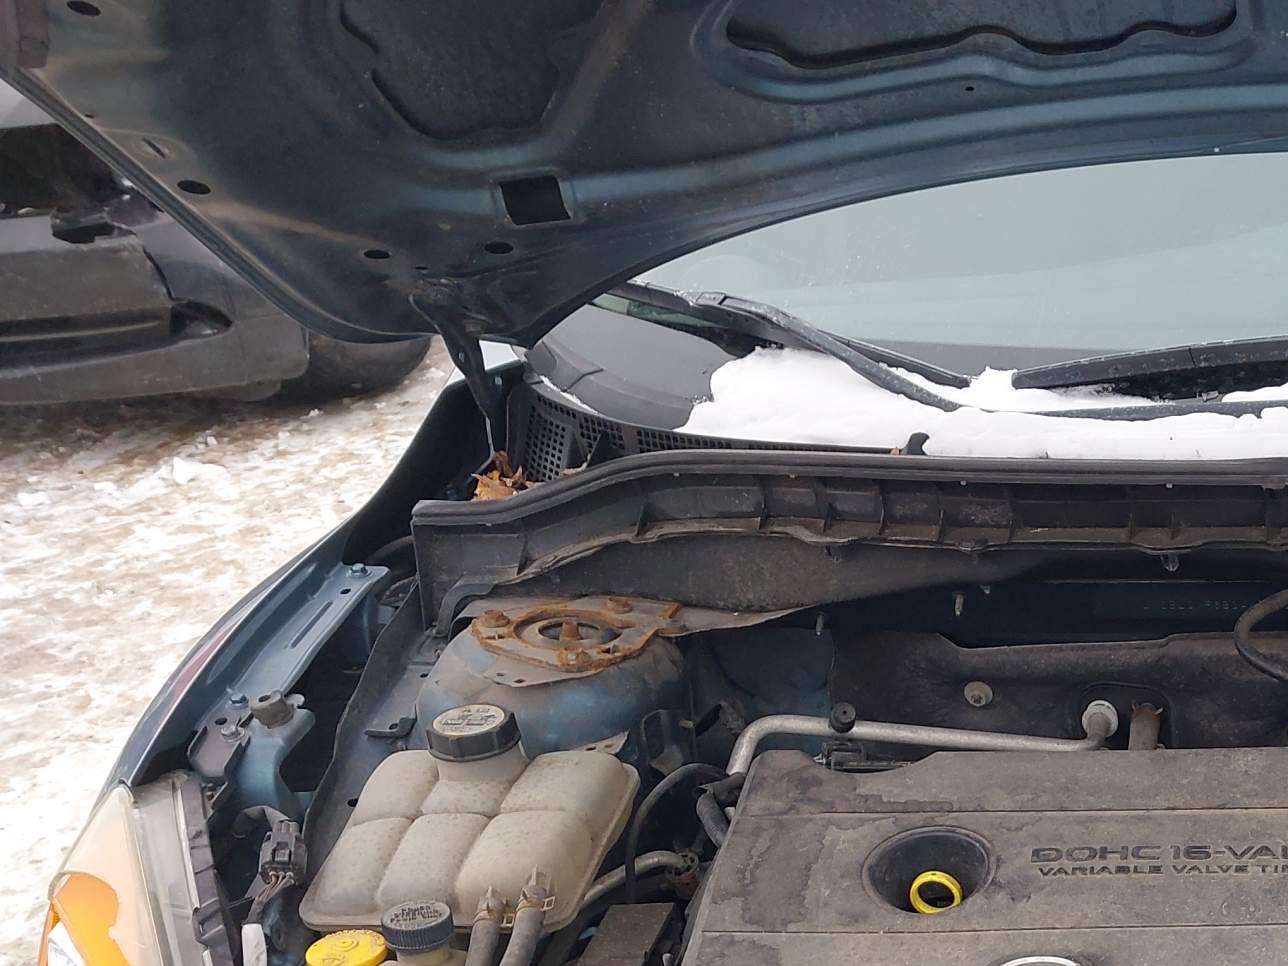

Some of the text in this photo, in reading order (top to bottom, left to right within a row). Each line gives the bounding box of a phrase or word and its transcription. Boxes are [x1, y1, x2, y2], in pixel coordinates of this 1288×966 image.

[1030, 844, 1162, 863] DOHC
[1037, 864, 1163, 877] VARIABLE
[1172, 863, 1250, 875] VALVE
